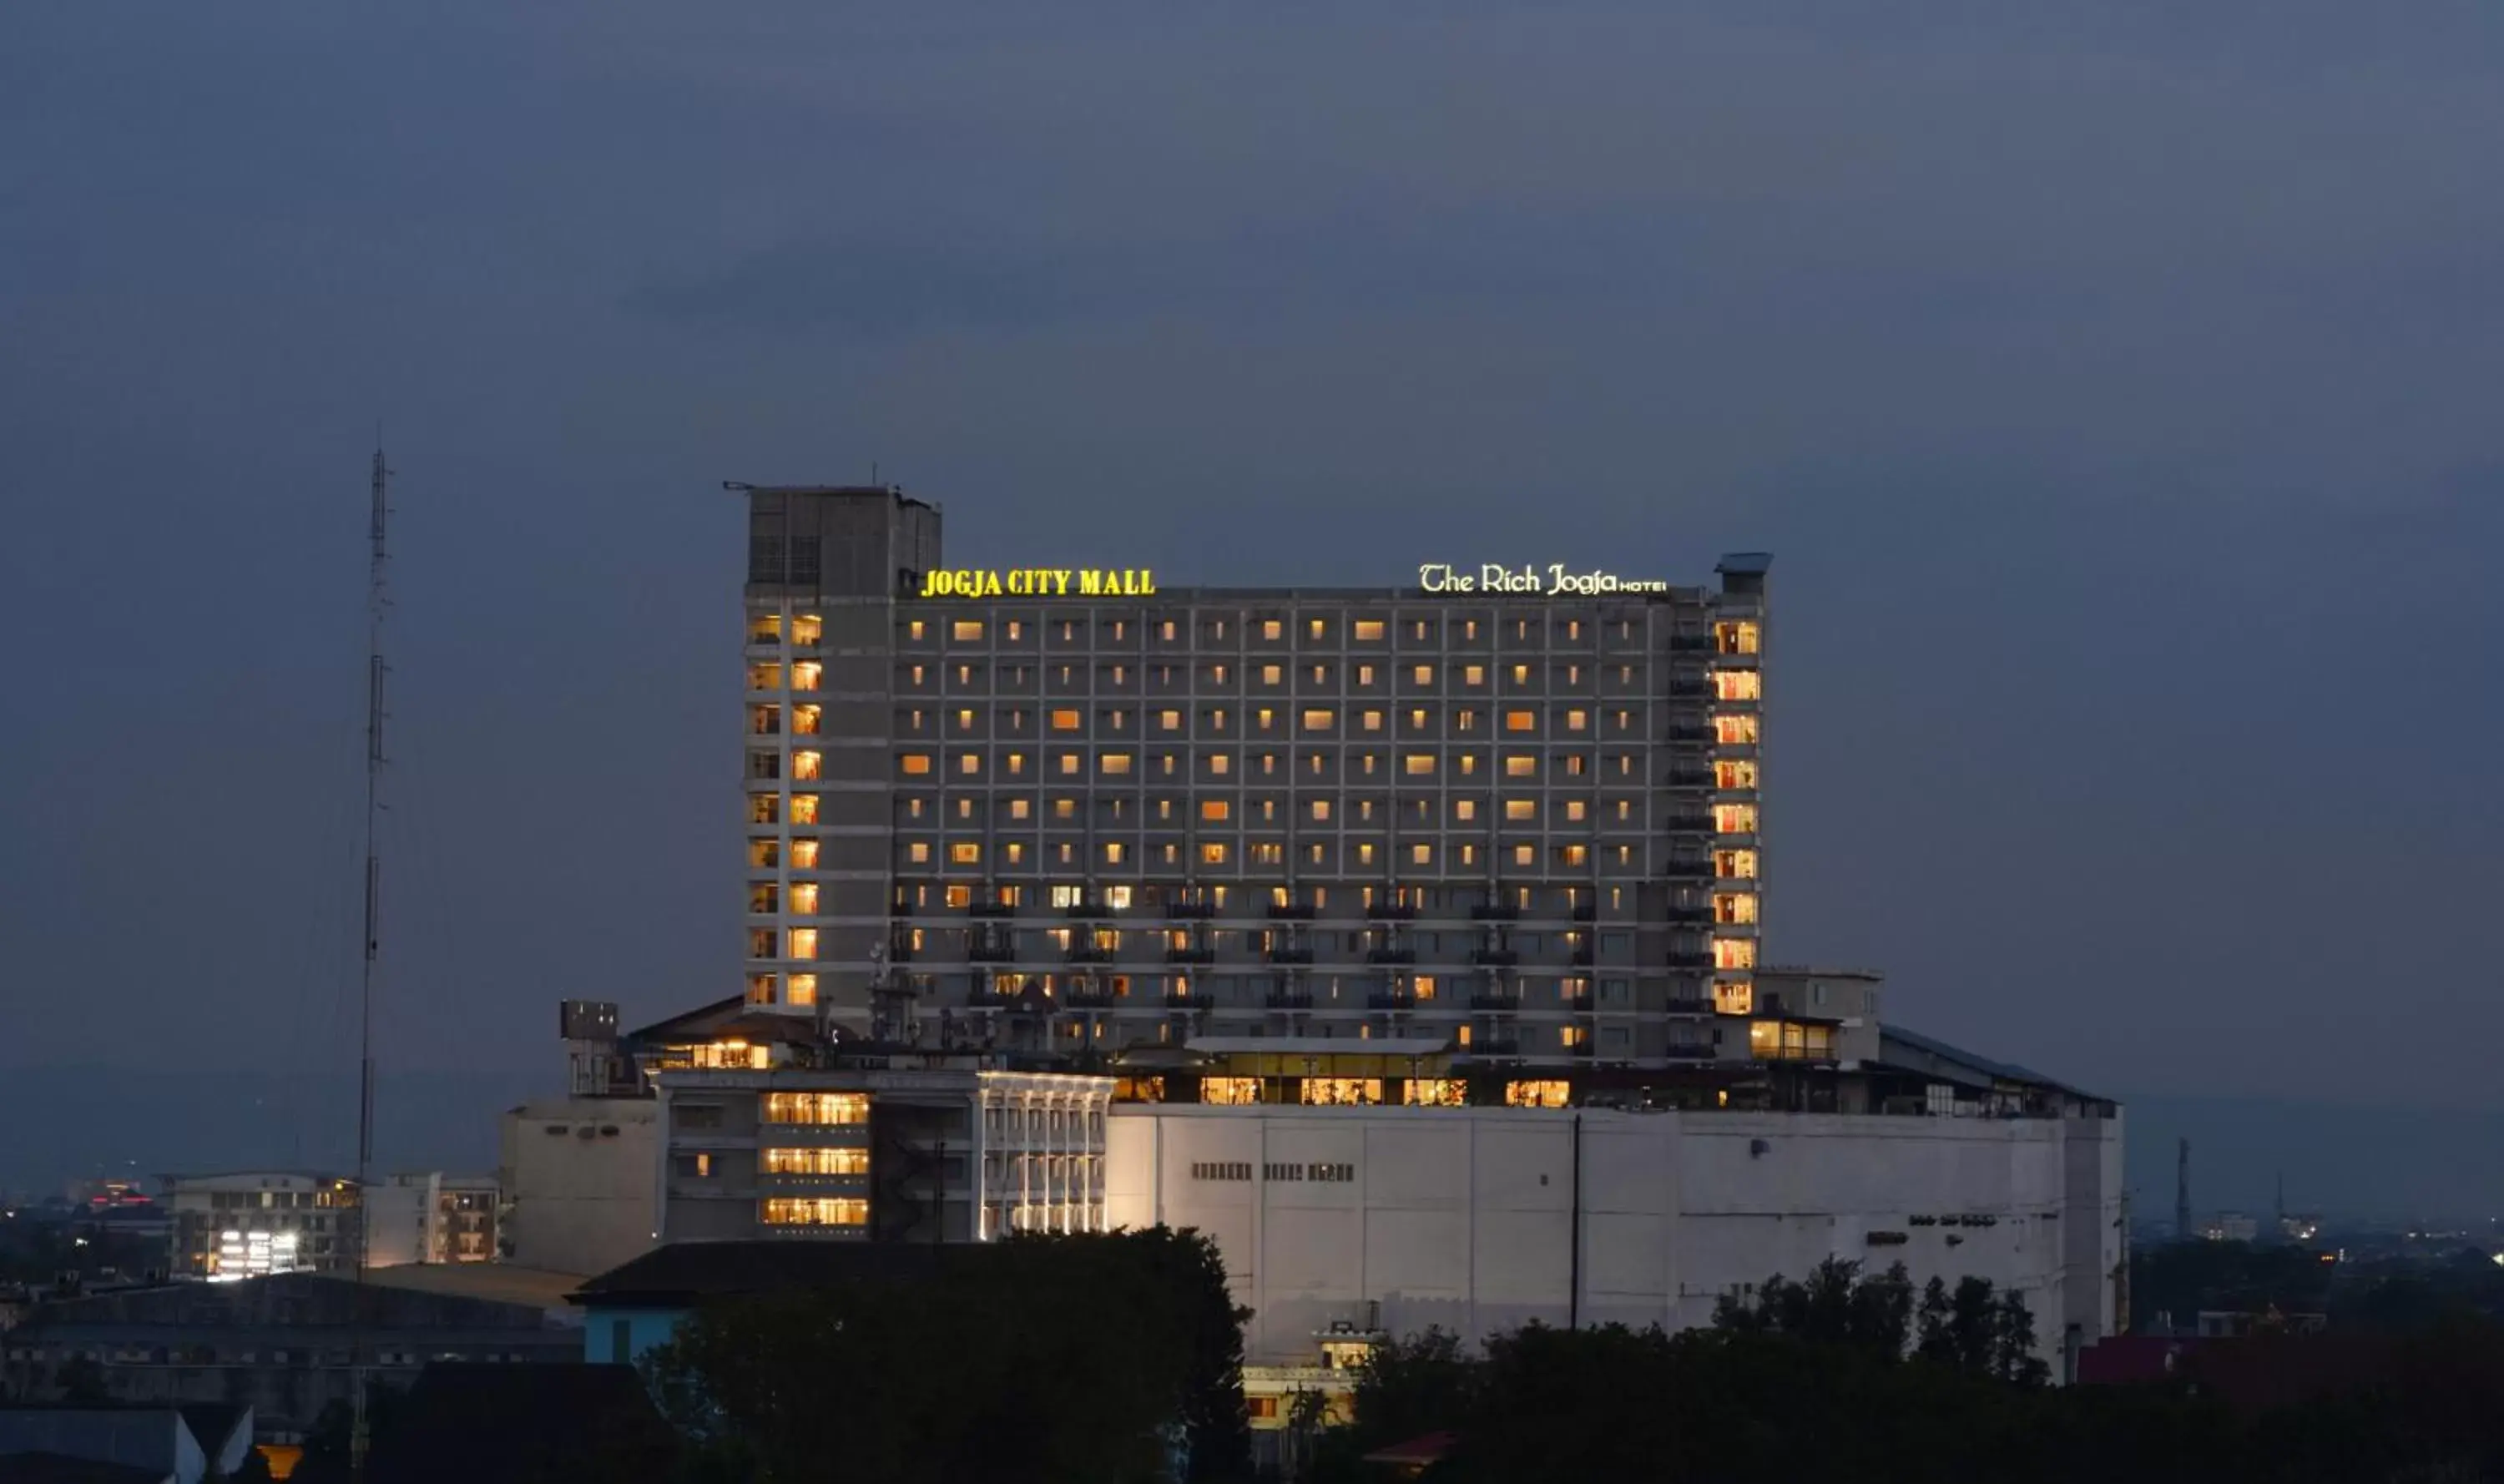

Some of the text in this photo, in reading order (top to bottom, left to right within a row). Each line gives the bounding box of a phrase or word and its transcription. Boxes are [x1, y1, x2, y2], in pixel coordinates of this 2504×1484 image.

[921, 569, 1155, 597] JOGJA CITY MALL
[1419, 563, 1474, 592] The
[1481, 564, 1541, 592] Rich
[1547, 563, 1618, 595] Jogja
